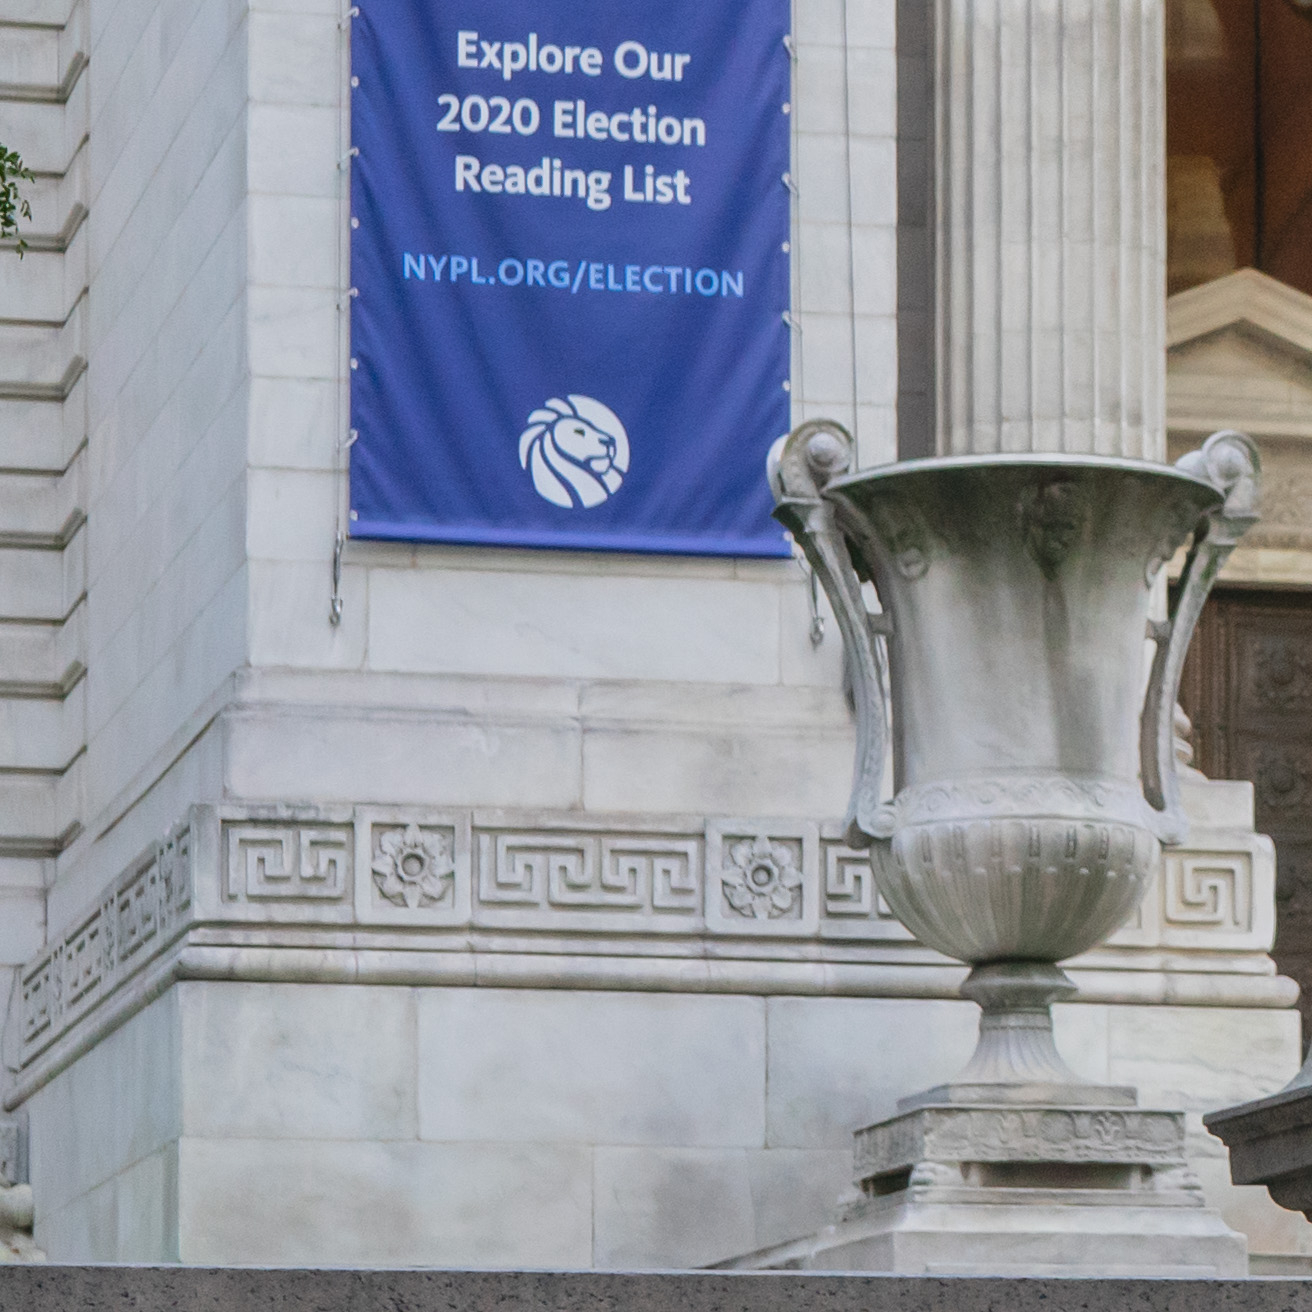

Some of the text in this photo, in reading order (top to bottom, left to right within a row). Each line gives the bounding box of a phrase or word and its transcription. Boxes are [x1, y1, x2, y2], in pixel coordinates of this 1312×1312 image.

[457, 31, 690, 82] Explore Our
[437, 94, 706, 146] 2020 Election
[455, 156, 690, 210] Reading List
[404, 253, 744, 297] NYPL.ORG/ELECTION
